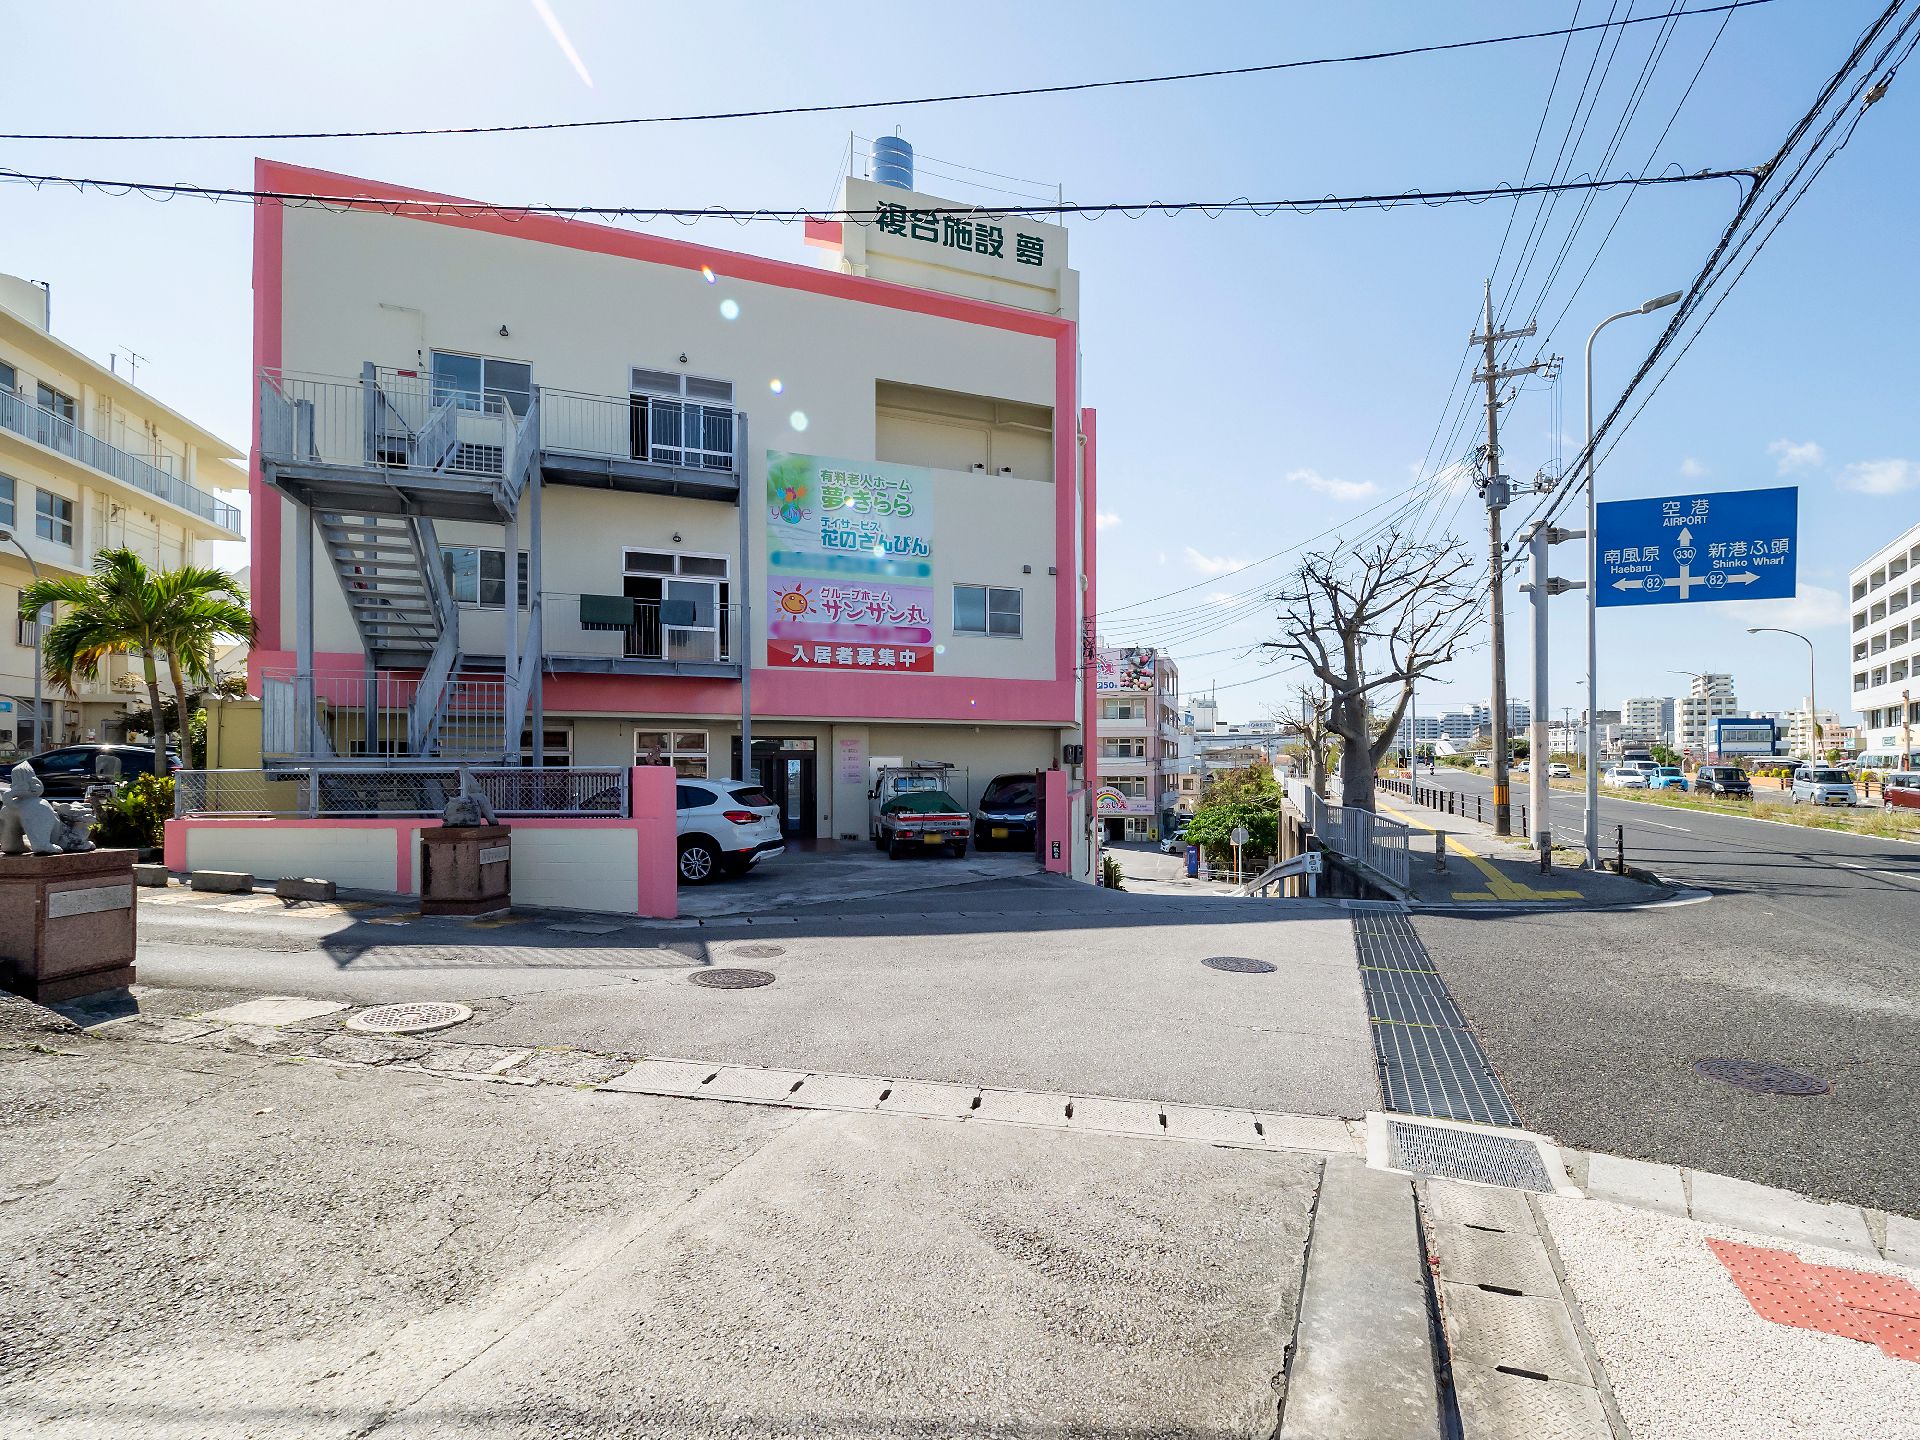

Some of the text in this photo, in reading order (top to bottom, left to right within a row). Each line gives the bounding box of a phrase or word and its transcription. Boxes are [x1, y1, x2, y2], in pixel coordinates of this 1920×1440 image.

[821, 470, 910, 490] 有料老人ホーム
[1663, 515, 1708, 527] AIRPORT
[821, 528, 929, 556] 花のさんぴん
[1708, 538, 1790, 558] 新港ふ頭
[1604, 546, 1660, 565] 南風原
[1676, 550, 1693, 559] 330
[1713, 555, 1785, 569] Shinko Wharf
[1610, 564, 1652, 574] Haebaru
[1646, 578, 1660, 589] 82
[1710, 574, 1723, 585] 82
[821, 587, 891, 602] グループホーム
[821, 600, 928, 623] サンサン丸
[791, 644, 916, 668] 入居者募集中
